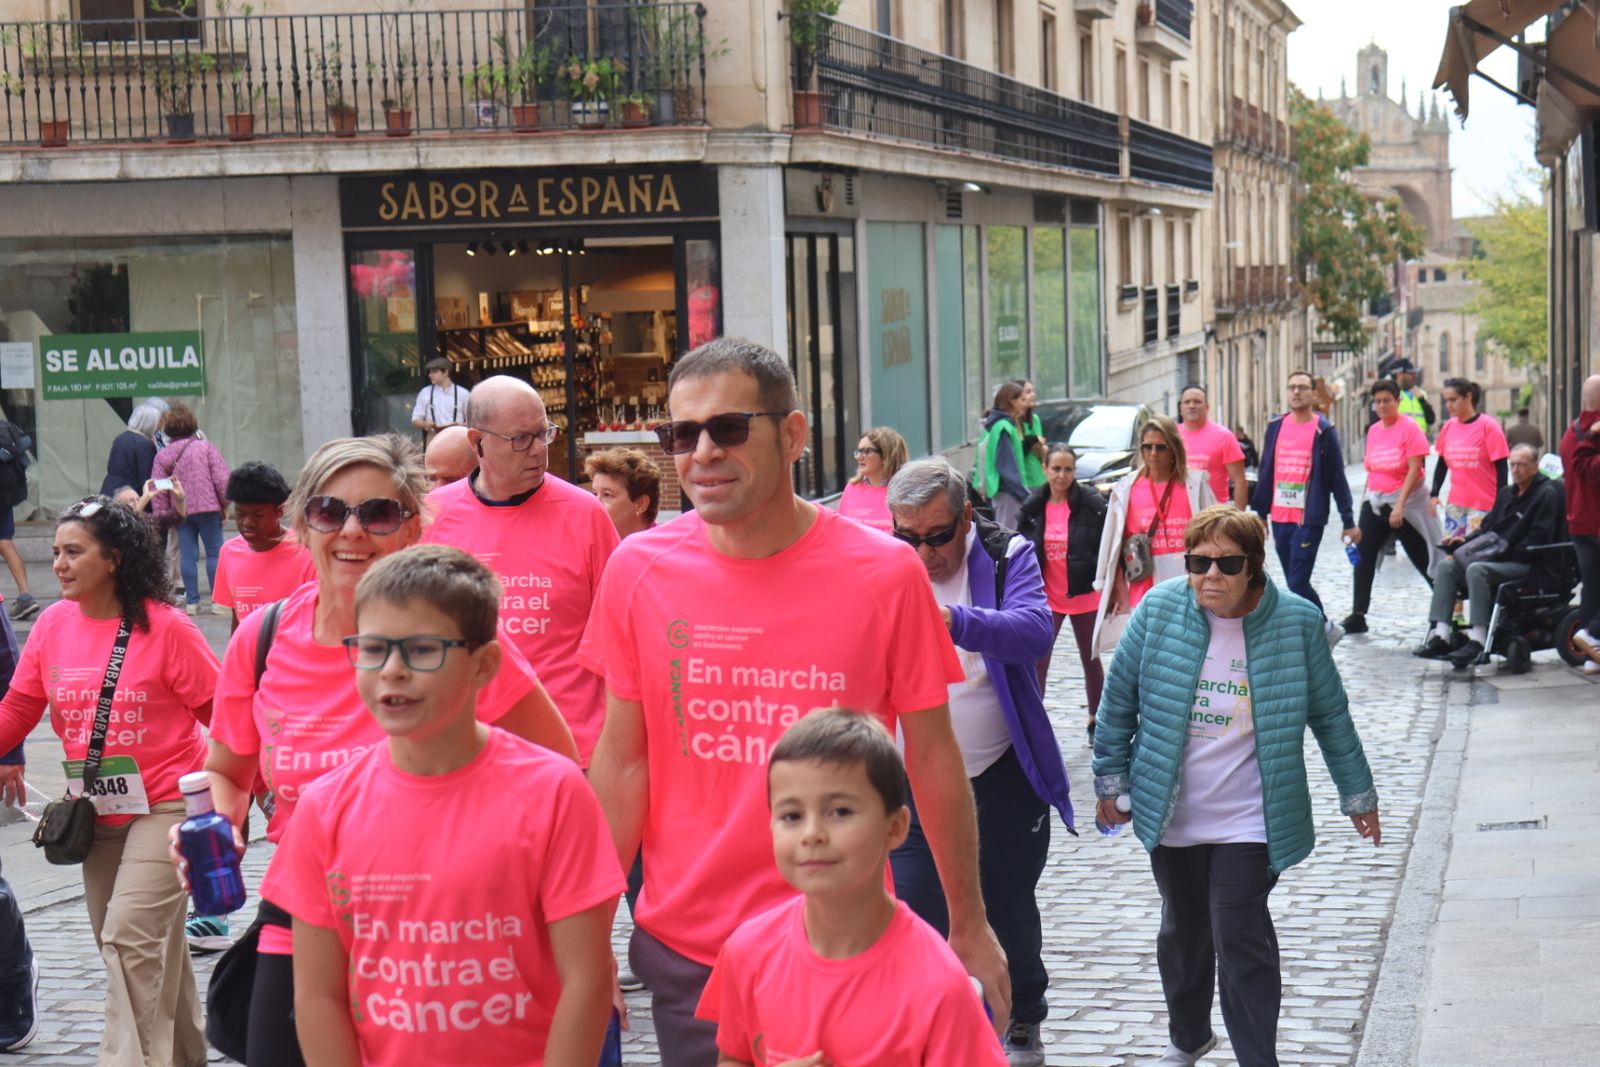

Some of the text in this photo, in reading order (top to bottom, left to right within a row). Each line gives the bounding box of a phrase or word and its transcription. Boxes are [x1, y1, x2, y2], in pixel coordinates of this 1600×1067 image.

[379, 174, 681, 221] SABOR A ESPAÑA
[46, 350, 79, 372] SE
[86, 345, 199, 371] ALQUILA
[499, 572, 552, 588] archa
[528, 592, 550, 610] el
[498, 616, 551, 634] cer
[103, 646, 126, 688] BIMBA
[687, 657, 846, 692] En marcha
[56, 687, 147, 702] En mcha
[1196, 679, 1248, 697] archa
[61, 705, 144, 723] cona el
[92, 697, 112, 740] BIMBA
[687, 694, 800, 728] contra
[1189, 710, 1233, 727] ncer
[64, 722, 147, 747] cácer
[691, 724, 778, 766] cán
[274, 745, 311, 771] En
[353, 912, 523, 944] En marcha
[357, 952, 484, 988] contra
[365, 986, 533, 1033] cáncer
